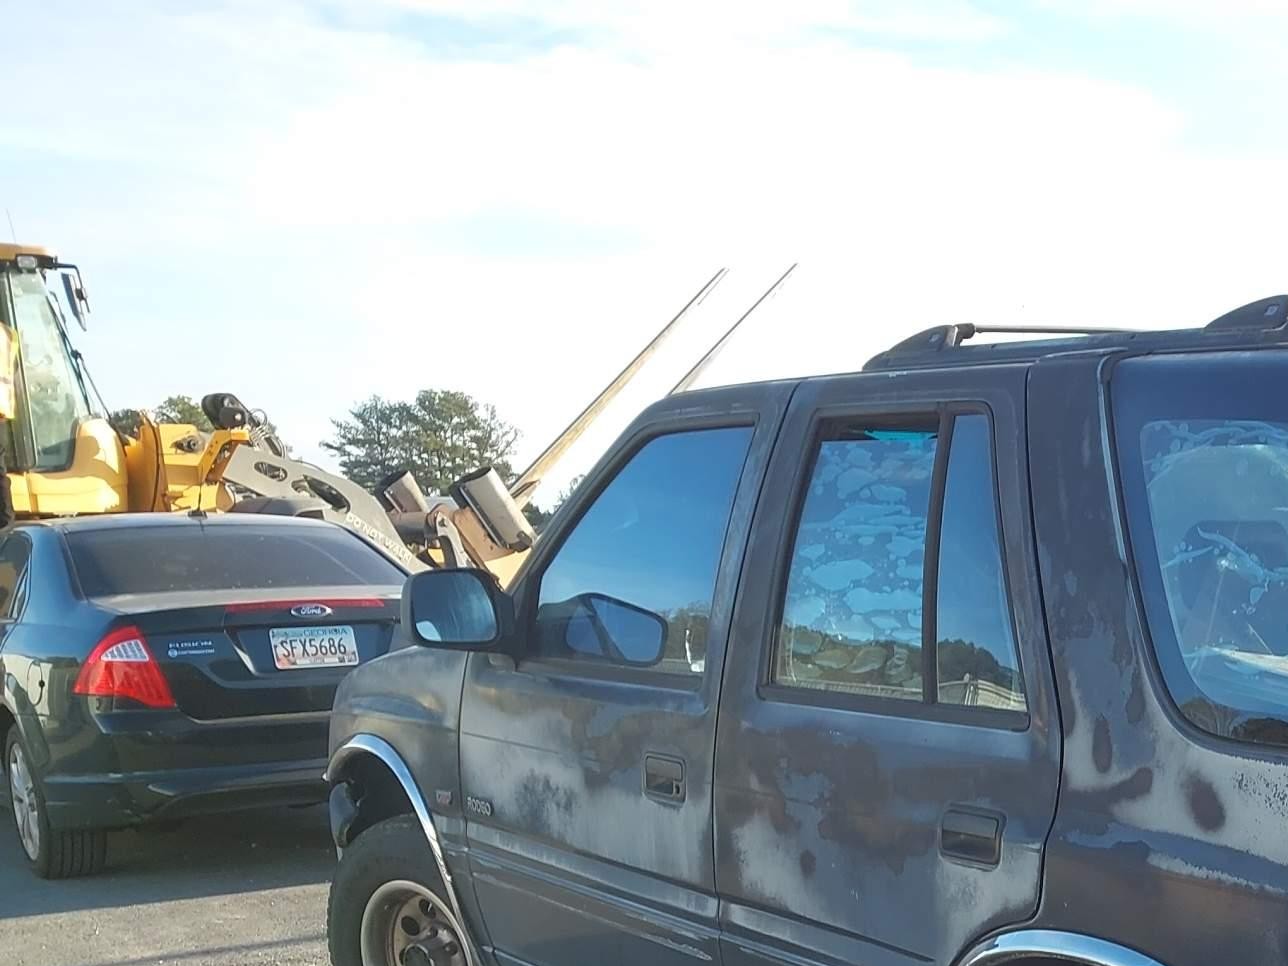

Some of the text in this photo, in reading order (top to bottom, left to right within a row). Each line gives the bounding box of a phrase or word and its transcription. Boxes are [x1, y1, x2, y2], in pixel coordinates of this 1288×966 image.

[345, 512, 362, 528] DO
[362, 522, 386, 544] NOT
[300, 606, 322, 615] Ford
[280, 637, 347, 658] SFX5686
[467, 796, 492, 817] RODEO
